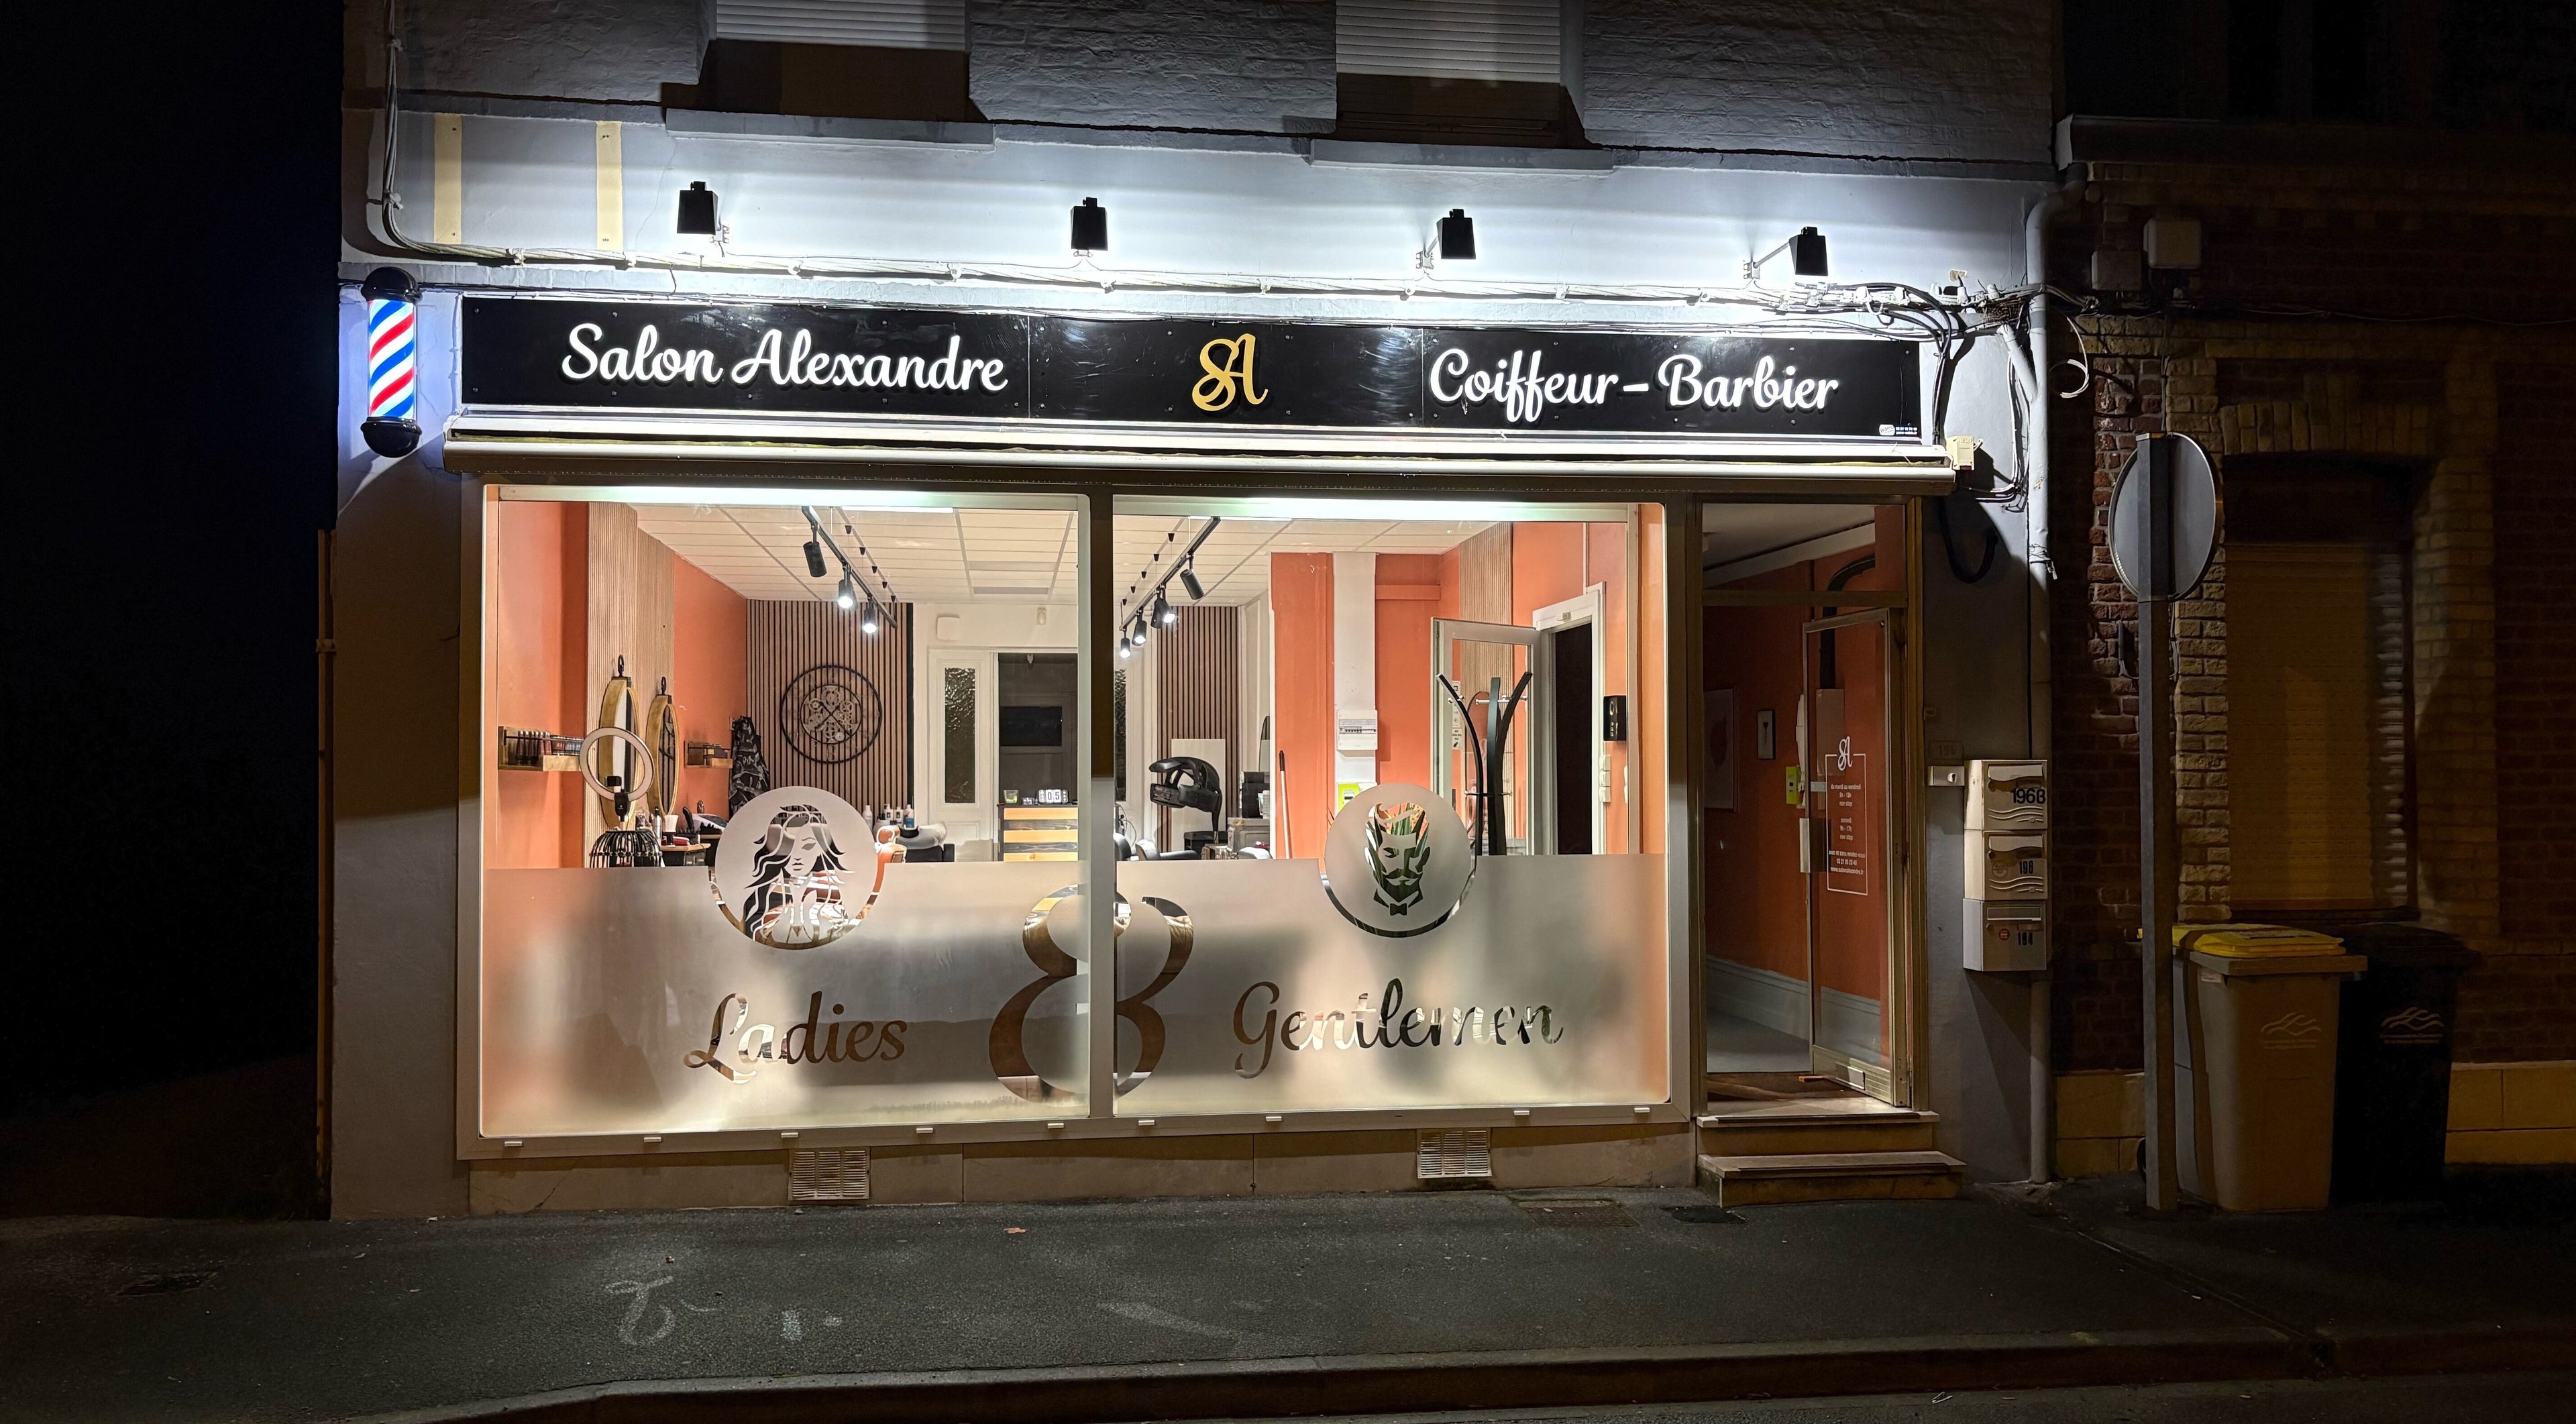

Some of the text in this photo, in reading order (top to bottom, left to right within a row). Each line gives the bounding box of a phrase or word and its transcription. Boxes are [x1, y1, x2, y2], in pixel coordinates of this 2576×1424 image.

[561, 323, 1008, 390] Salon Alexandre
[1430, 349, 1619, 423] Coiffeur
[1657, 355, 1840, 412] Barbier
[683, 991, 908, 1085] Ladies
[1232, 978, 1564, 1079] Gentlemen
